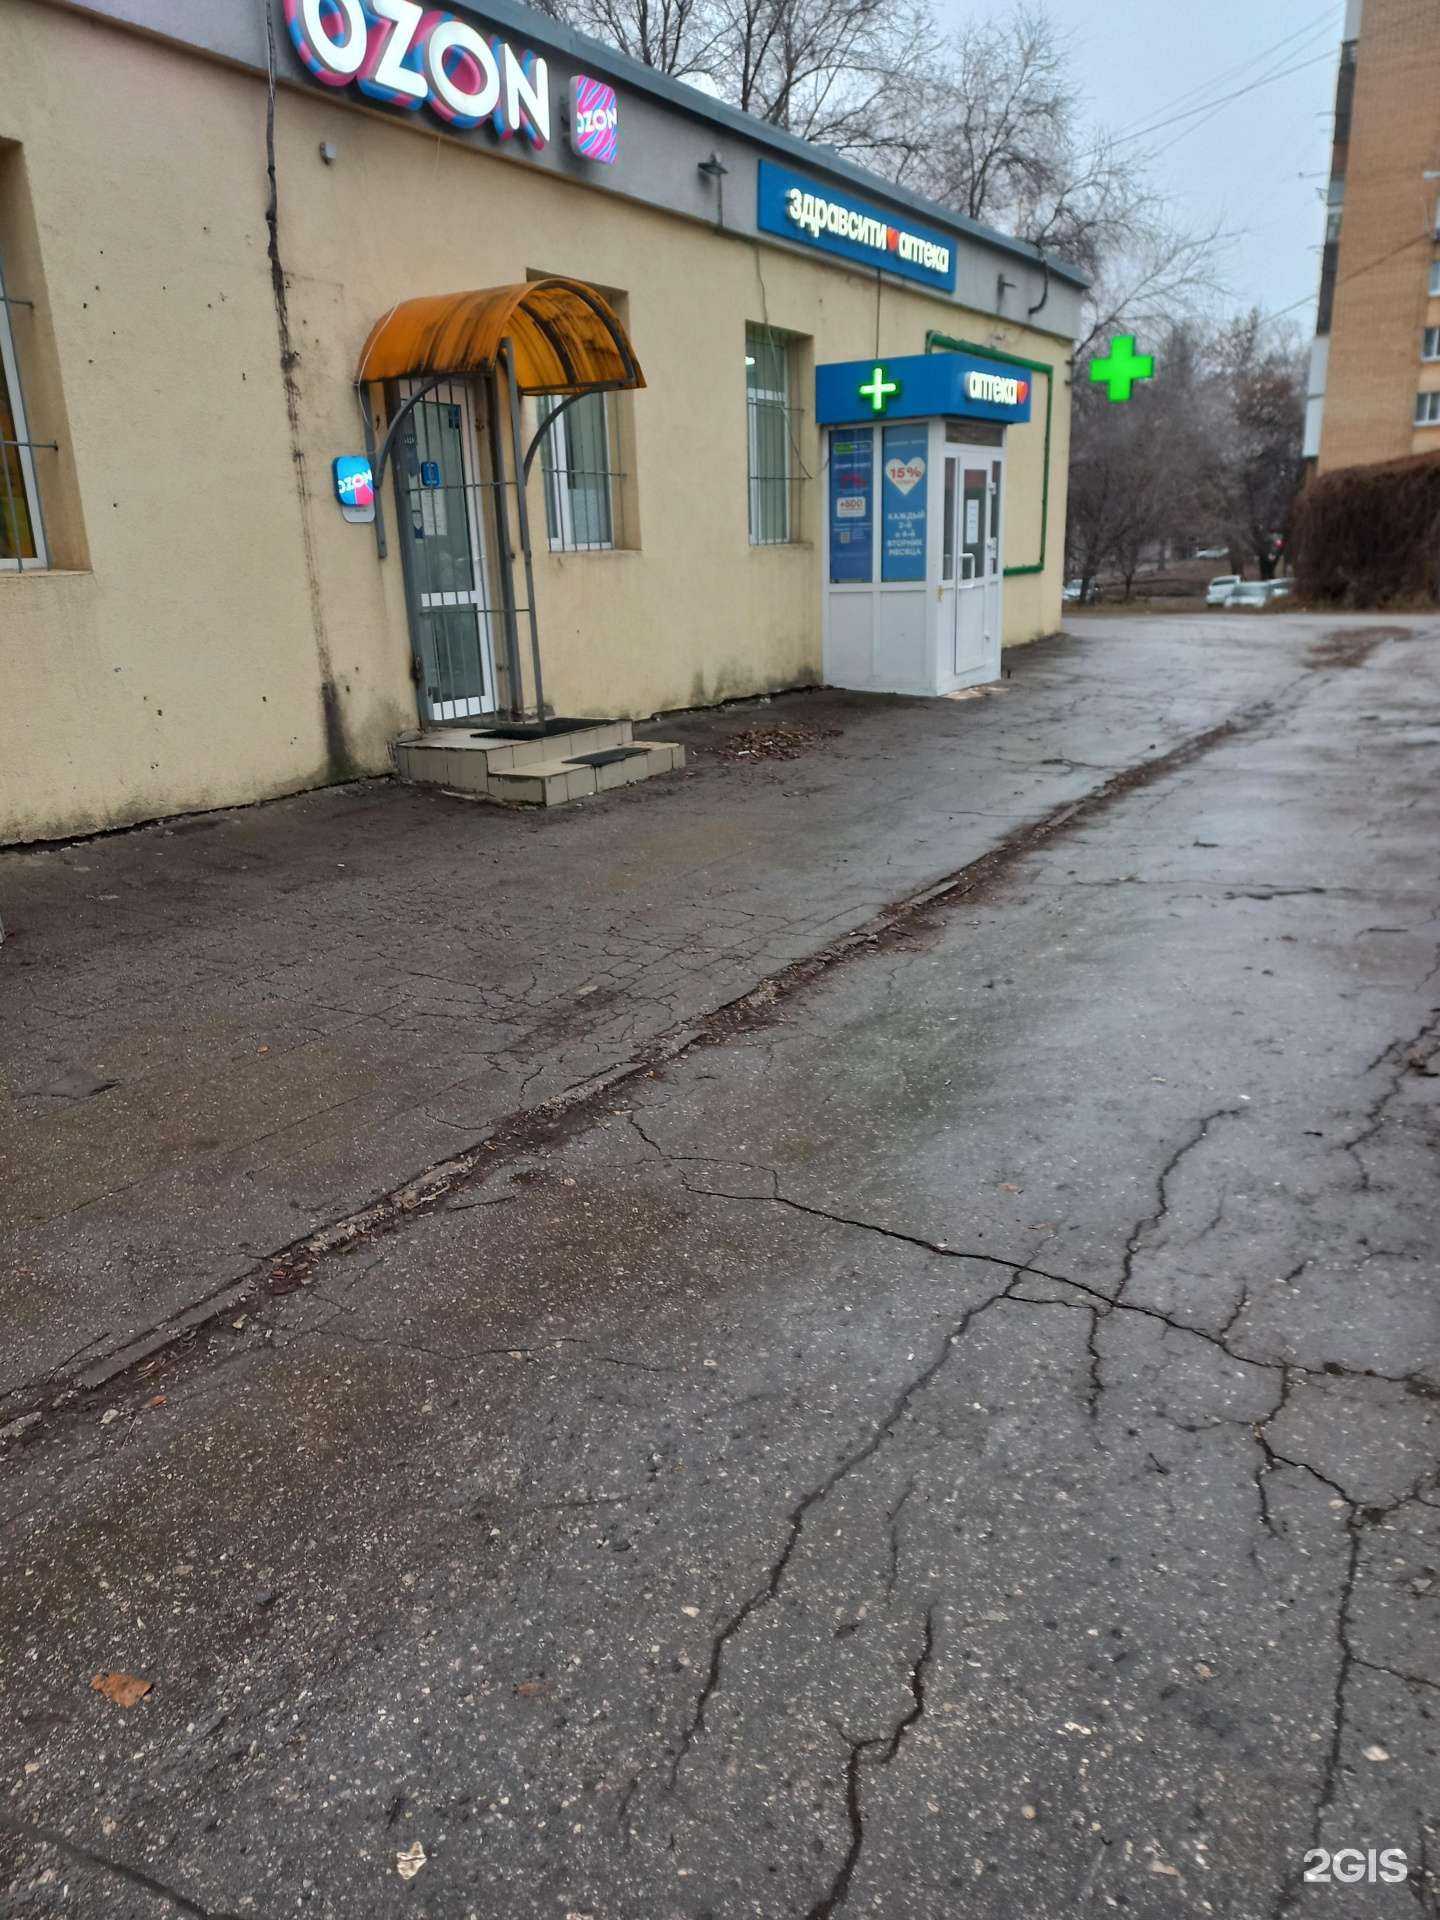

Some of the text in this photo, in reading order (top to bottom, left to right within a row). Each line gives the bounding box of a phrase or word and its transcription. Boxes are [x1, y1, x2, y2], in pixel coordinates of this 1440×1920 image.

[298, 0, 550, 142] OZON
[898, 231, 949, 274] аптека
[967, 370, 1018, 406] аптека
